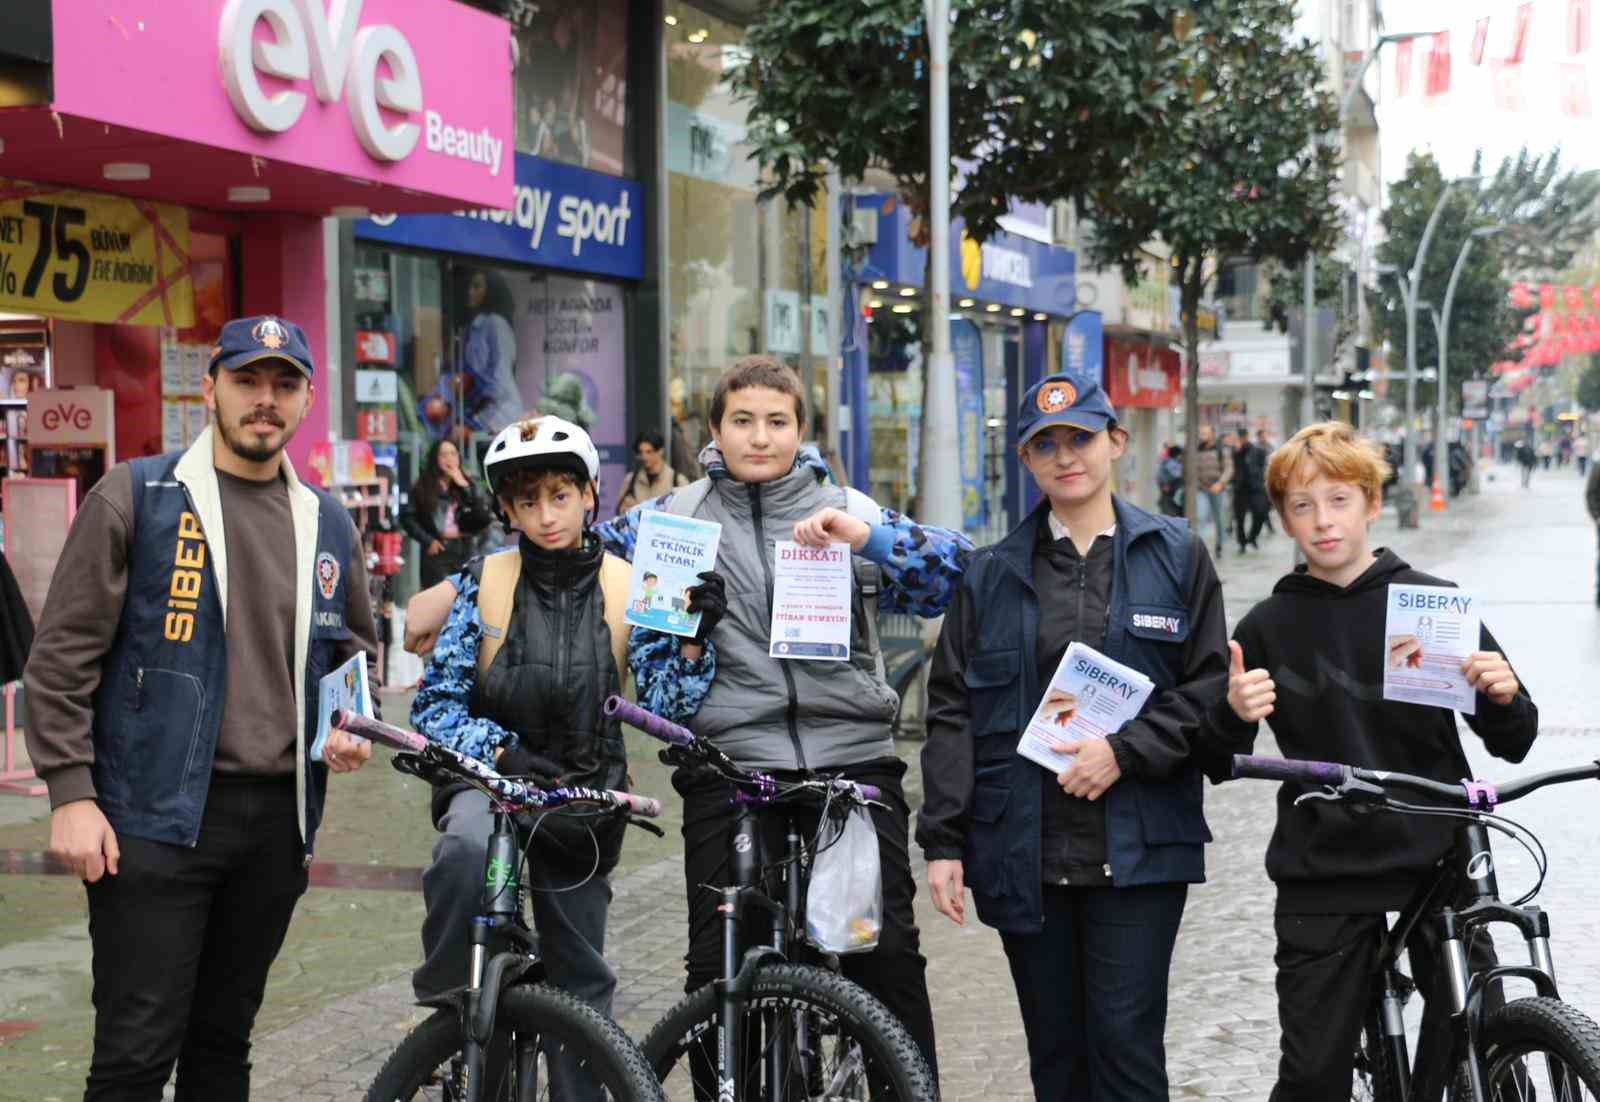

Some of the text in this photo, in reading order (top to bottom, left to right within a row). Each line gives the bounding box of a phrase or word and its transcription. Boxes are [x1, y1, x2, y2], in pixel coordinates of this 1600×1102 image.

[218, 0, 423, 162] eve
[425, 110, 503, 177] Beauty
[557, 190, 632, 257] sport
[42, 404, 92, 431] eve
[781, 547, 843, 563] DİKKAT!
